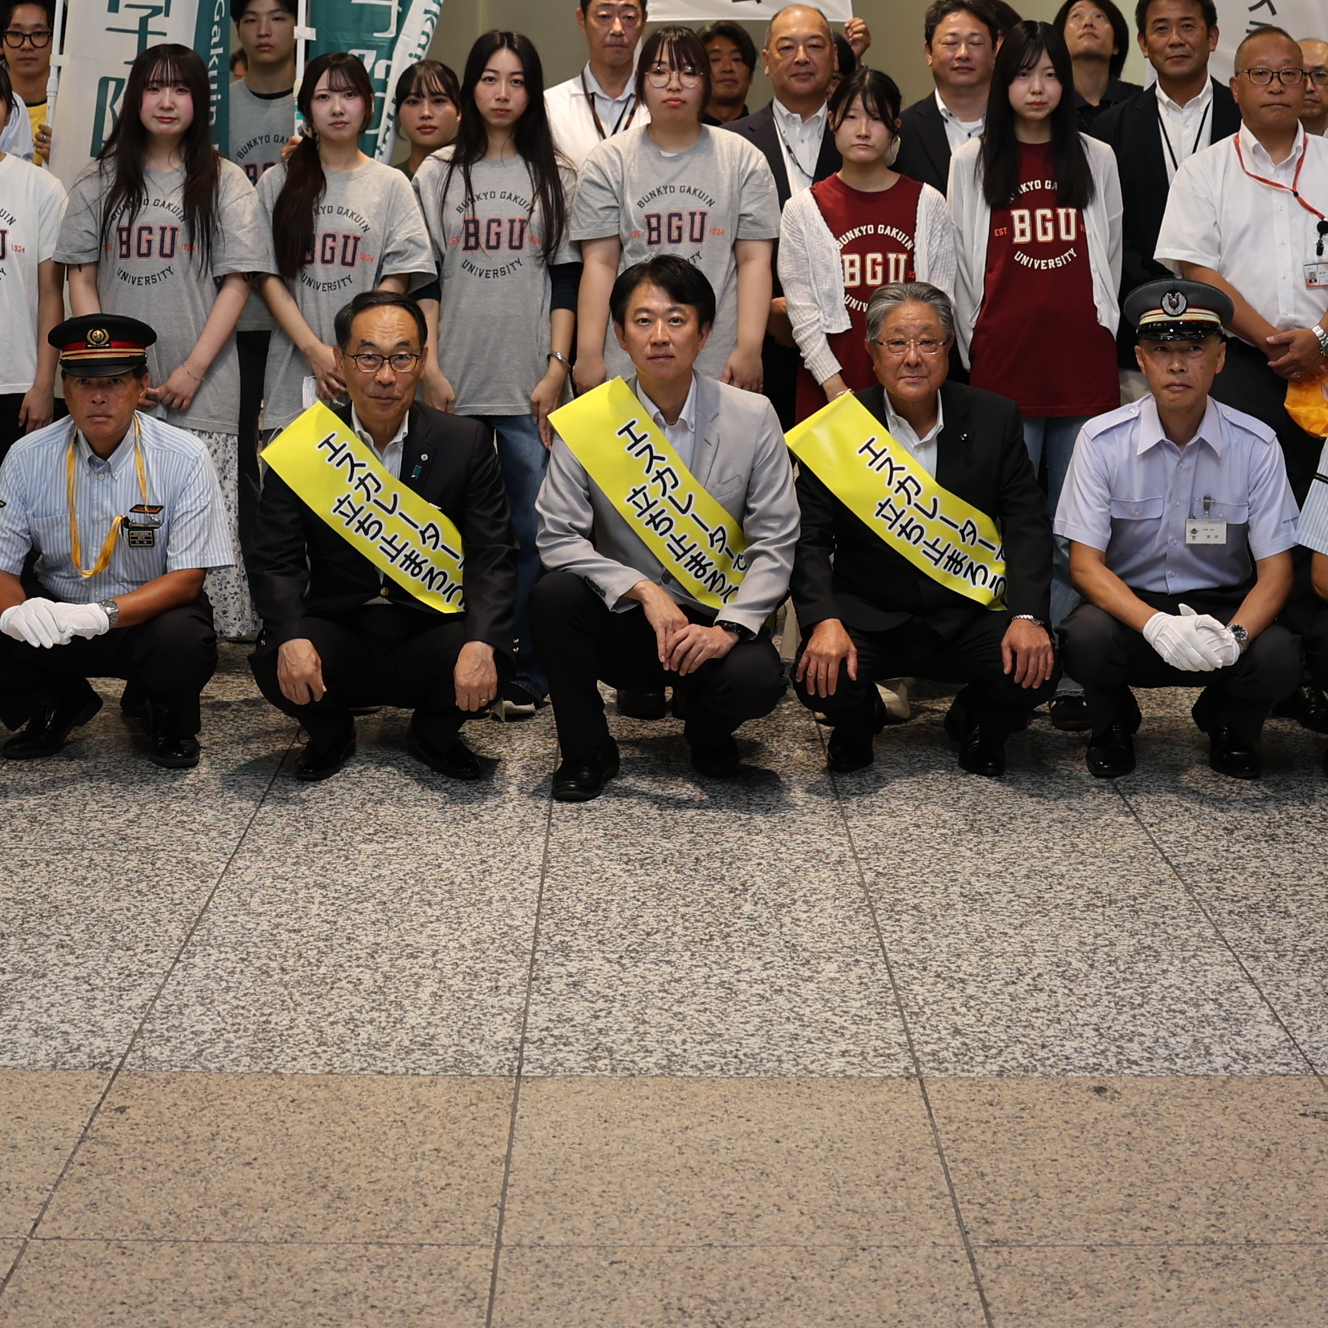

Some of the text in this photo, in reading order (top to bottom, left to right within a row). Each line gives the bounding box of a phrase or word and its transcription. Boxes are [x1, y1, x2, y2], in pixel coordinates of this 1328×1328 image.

[236, 134, 270, 160] BUNKYO
[636, 185, 716, 209] BUNKYO GAKUIN
[336, 206, 371, 234] GAKUIN
[644, 210, 710, 247] BGU
[1010, 207, 1078, 245] BGU
[117, 224, 181, 261] BGU
[461, 217, 529, 252] BGU
[836, 224, 914, 251] BUNKYO GAKUIN
[11, 243, 26, 254] 1924
[1013, 247, 1078, 270] UNIVERSITY
[116, 265, 174, 286] UNIVERSITY
[461, 257, 523, 279] UNIVERSITY
[841, 253, 908, 288] BGU
[301, 274, 353, 292] UNIVERSITY
